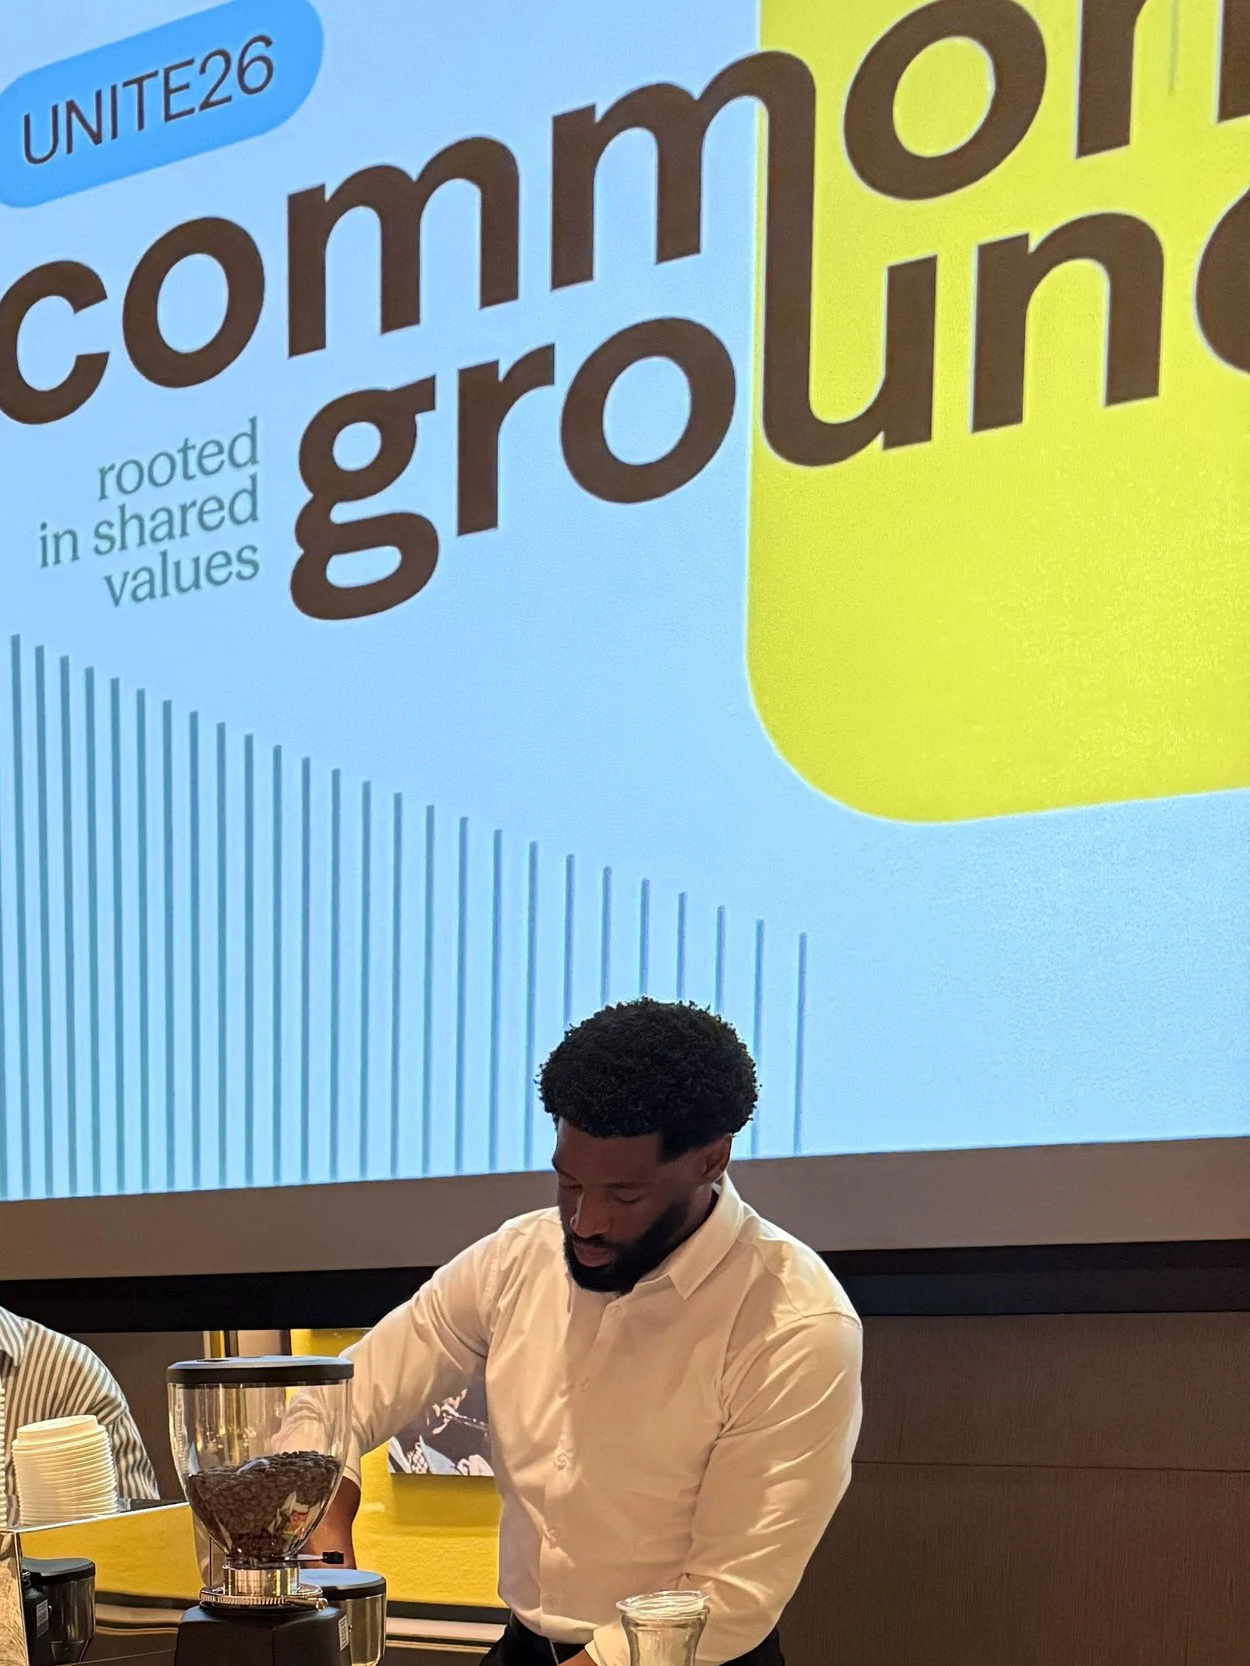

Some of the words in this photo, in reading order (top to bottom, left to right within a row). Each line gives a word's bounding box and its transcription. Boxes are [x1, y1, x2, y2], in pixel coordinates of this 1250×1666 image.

[23, 35, 274, 165] UNITE26
[98, 416, 259, 501] rooted
[40, 521, 80, 569] in
[93, 472, 259, 556] shared
[104, 544, 260, 607] values
